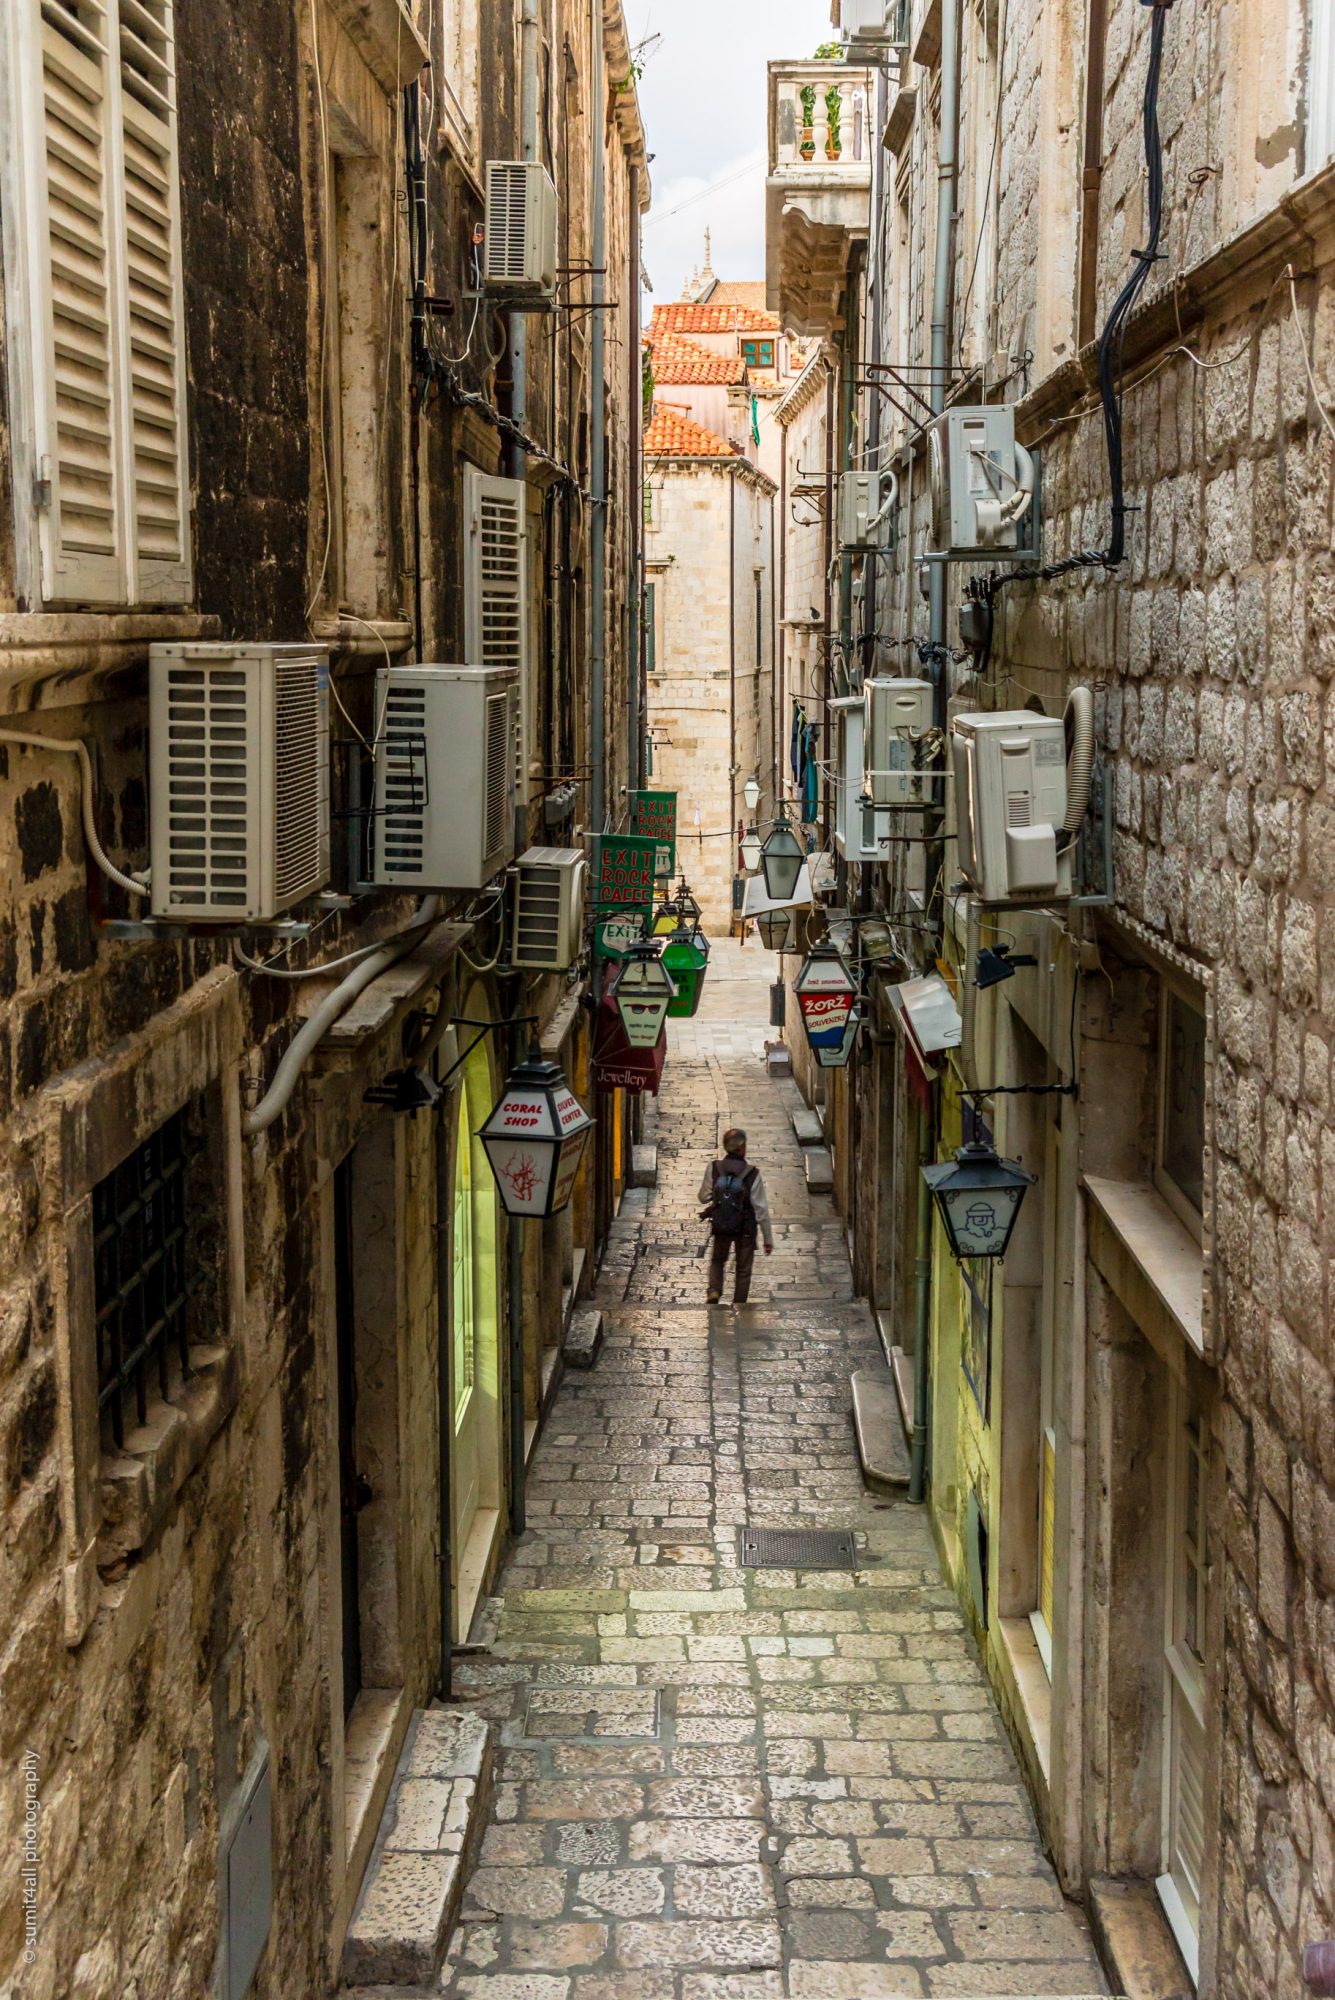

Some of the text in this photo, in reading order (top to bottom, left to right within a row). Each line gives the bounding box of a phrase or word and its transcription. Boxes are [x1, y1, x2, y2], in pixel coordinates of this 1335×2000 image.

[637, 801, 674, 813] EXIT
[637, 814, 675, 827] ROCK
[602, 849, 653, 868] EXIT
[601, 867, 652, 886] ROCK
[601, 886, 651, 906] CAFFE
[607, 924, 640, 939] EXIT
[805, 994, 847, 1013] ŽORŽ
[807, 1014, 847, 1029] SOUVENIRS
[597, 1069, 647, 1089] Jewellery
[503, 1103, 543, 1114] CORAL
[557, 1097, 576, 1113] SILVER
[503, 1117, 539, 1127] SHOP
[561, 1107, 583, 1125] CENTER
